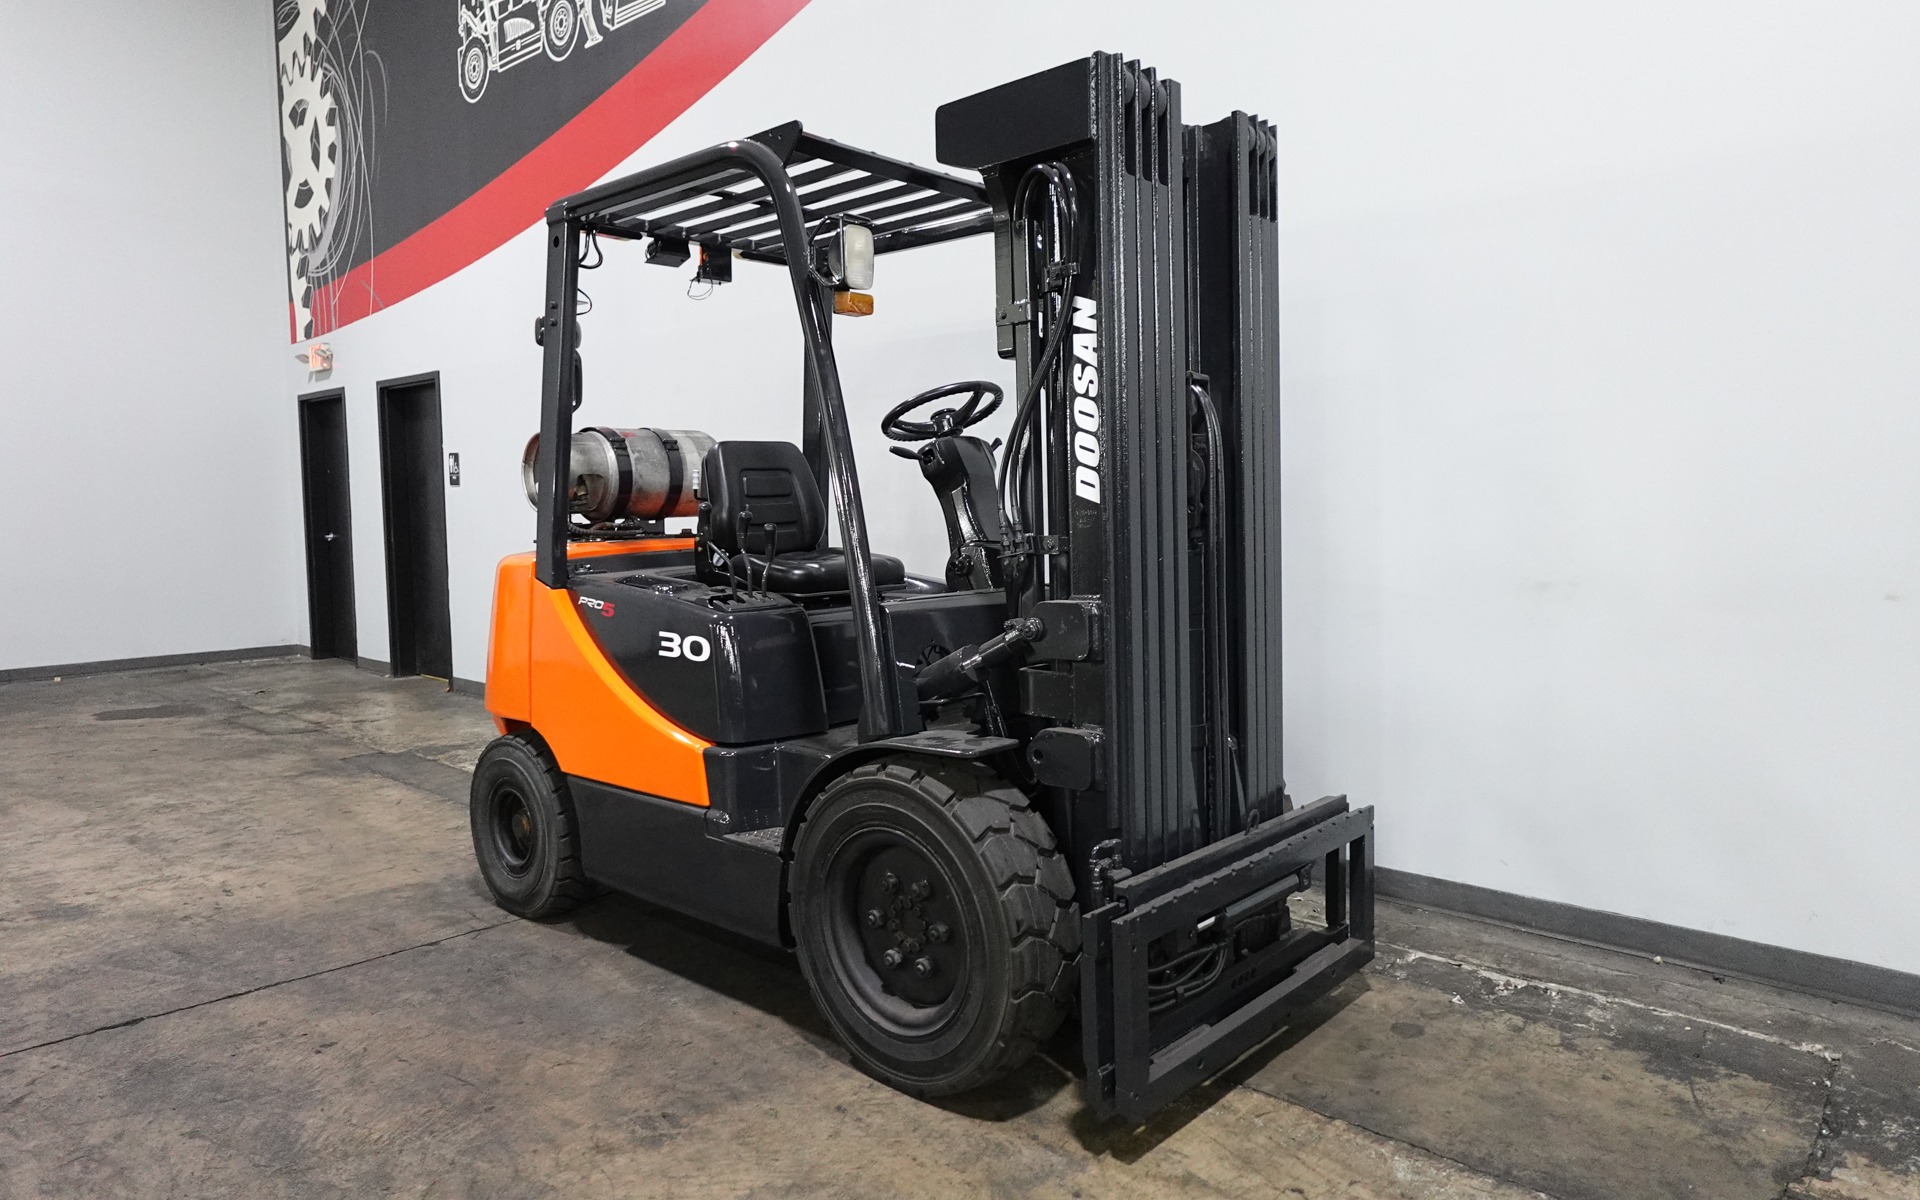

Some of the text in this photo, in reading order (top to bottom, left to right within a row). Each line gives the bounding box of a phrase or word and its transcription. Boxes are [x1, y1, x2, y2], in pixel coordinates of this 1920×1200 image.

[1072, 295, 1101, 504] DOOSAN
[578, 596, 615, 617] PRO5
[658, 630, 711, 662] 30
